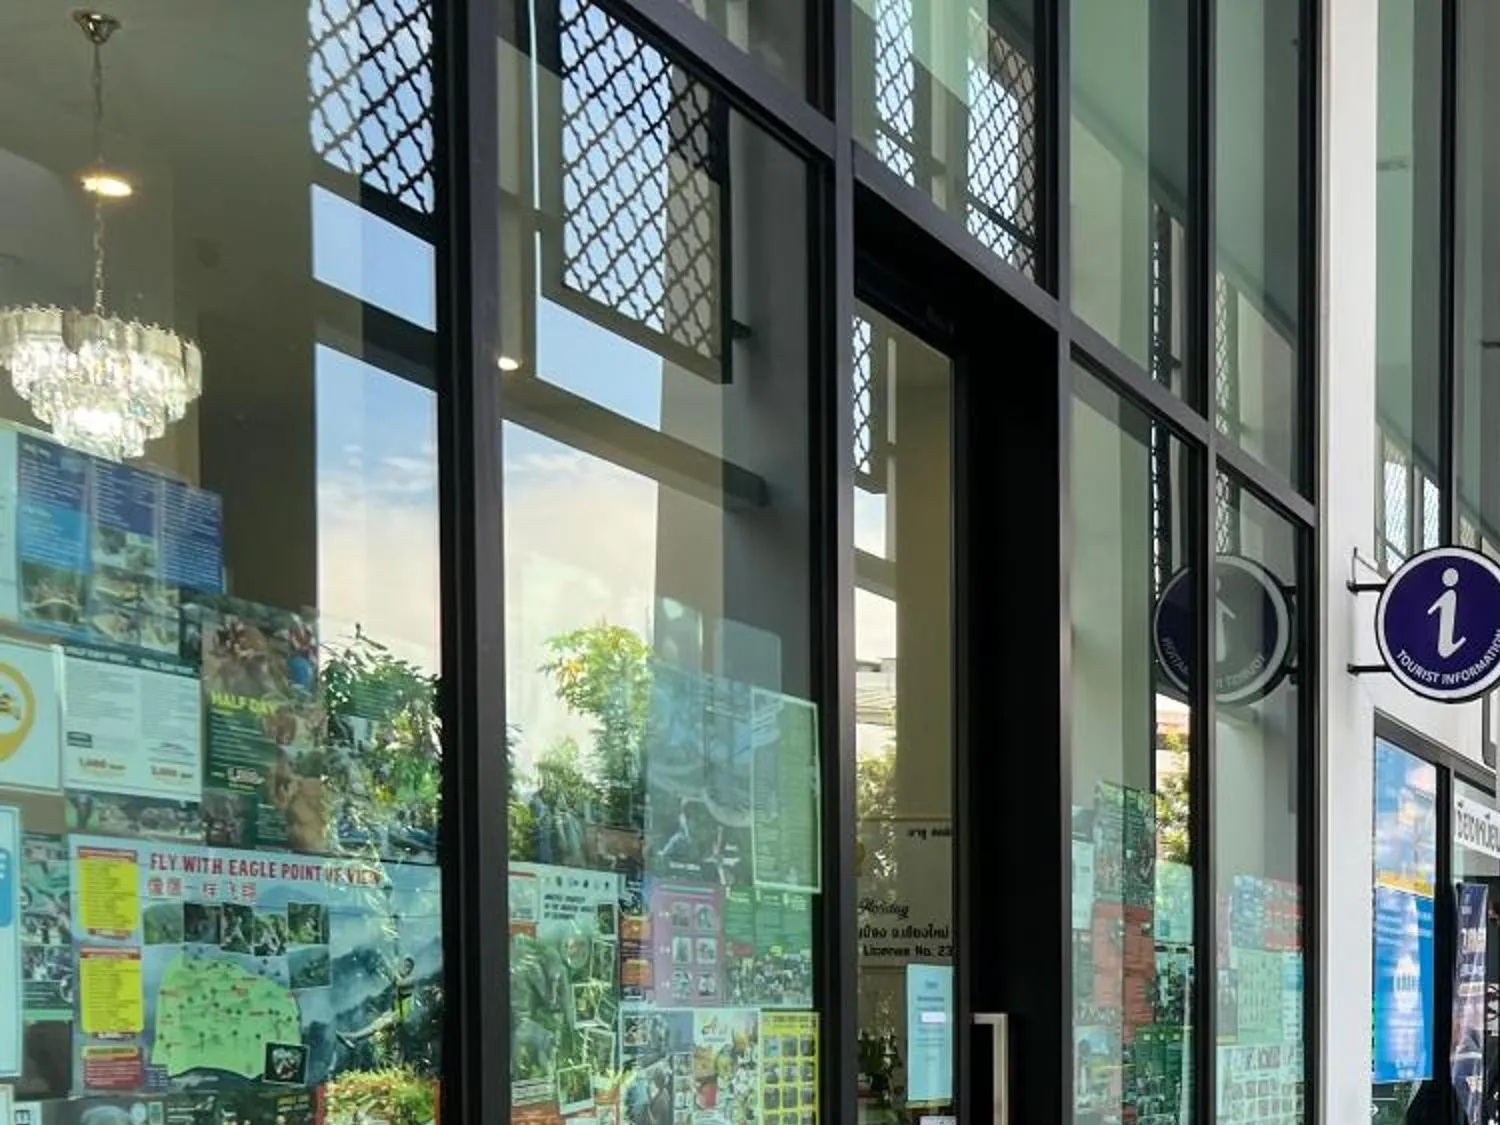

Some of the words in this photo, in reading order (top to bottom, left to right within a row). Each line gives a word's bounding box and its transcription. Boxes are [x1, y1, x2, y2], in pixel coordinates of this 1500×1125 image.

[1396, 649, 1440, 683] TOURIST
[151, 852, 177, 871] FLY
[182, 855, 223, 875] WITH
[228, 859, 276, 879] EAGLE
[281, 863, 322, 881] POINT
[863, 944, 911, 957] License
